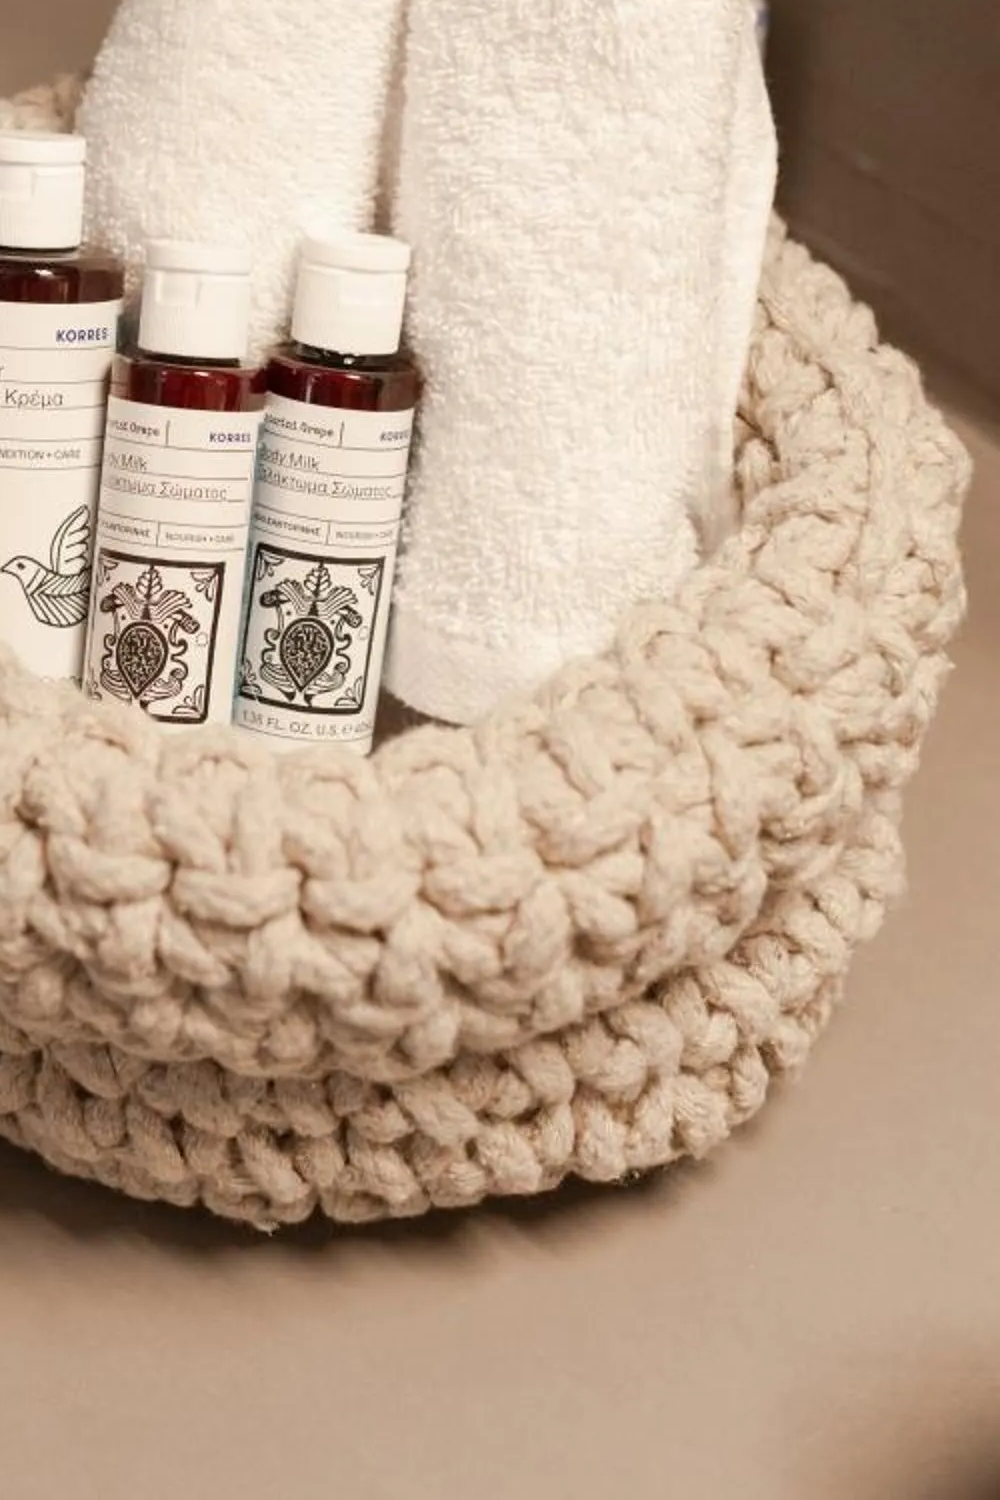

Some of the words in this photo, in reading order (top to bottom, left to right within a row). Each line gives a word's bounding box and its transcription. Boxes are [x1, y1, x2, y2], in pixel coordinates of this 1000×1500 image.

[56, 327, 110, 343] KORRES
[5, 387, 64, 410] Κρέμα
[209, 432, 251, 443] KORRES
[121, 453, 148, 471] Milk
[289, 452, 319, 472] Milk
[159, 481, 228, 501] Σώματος
